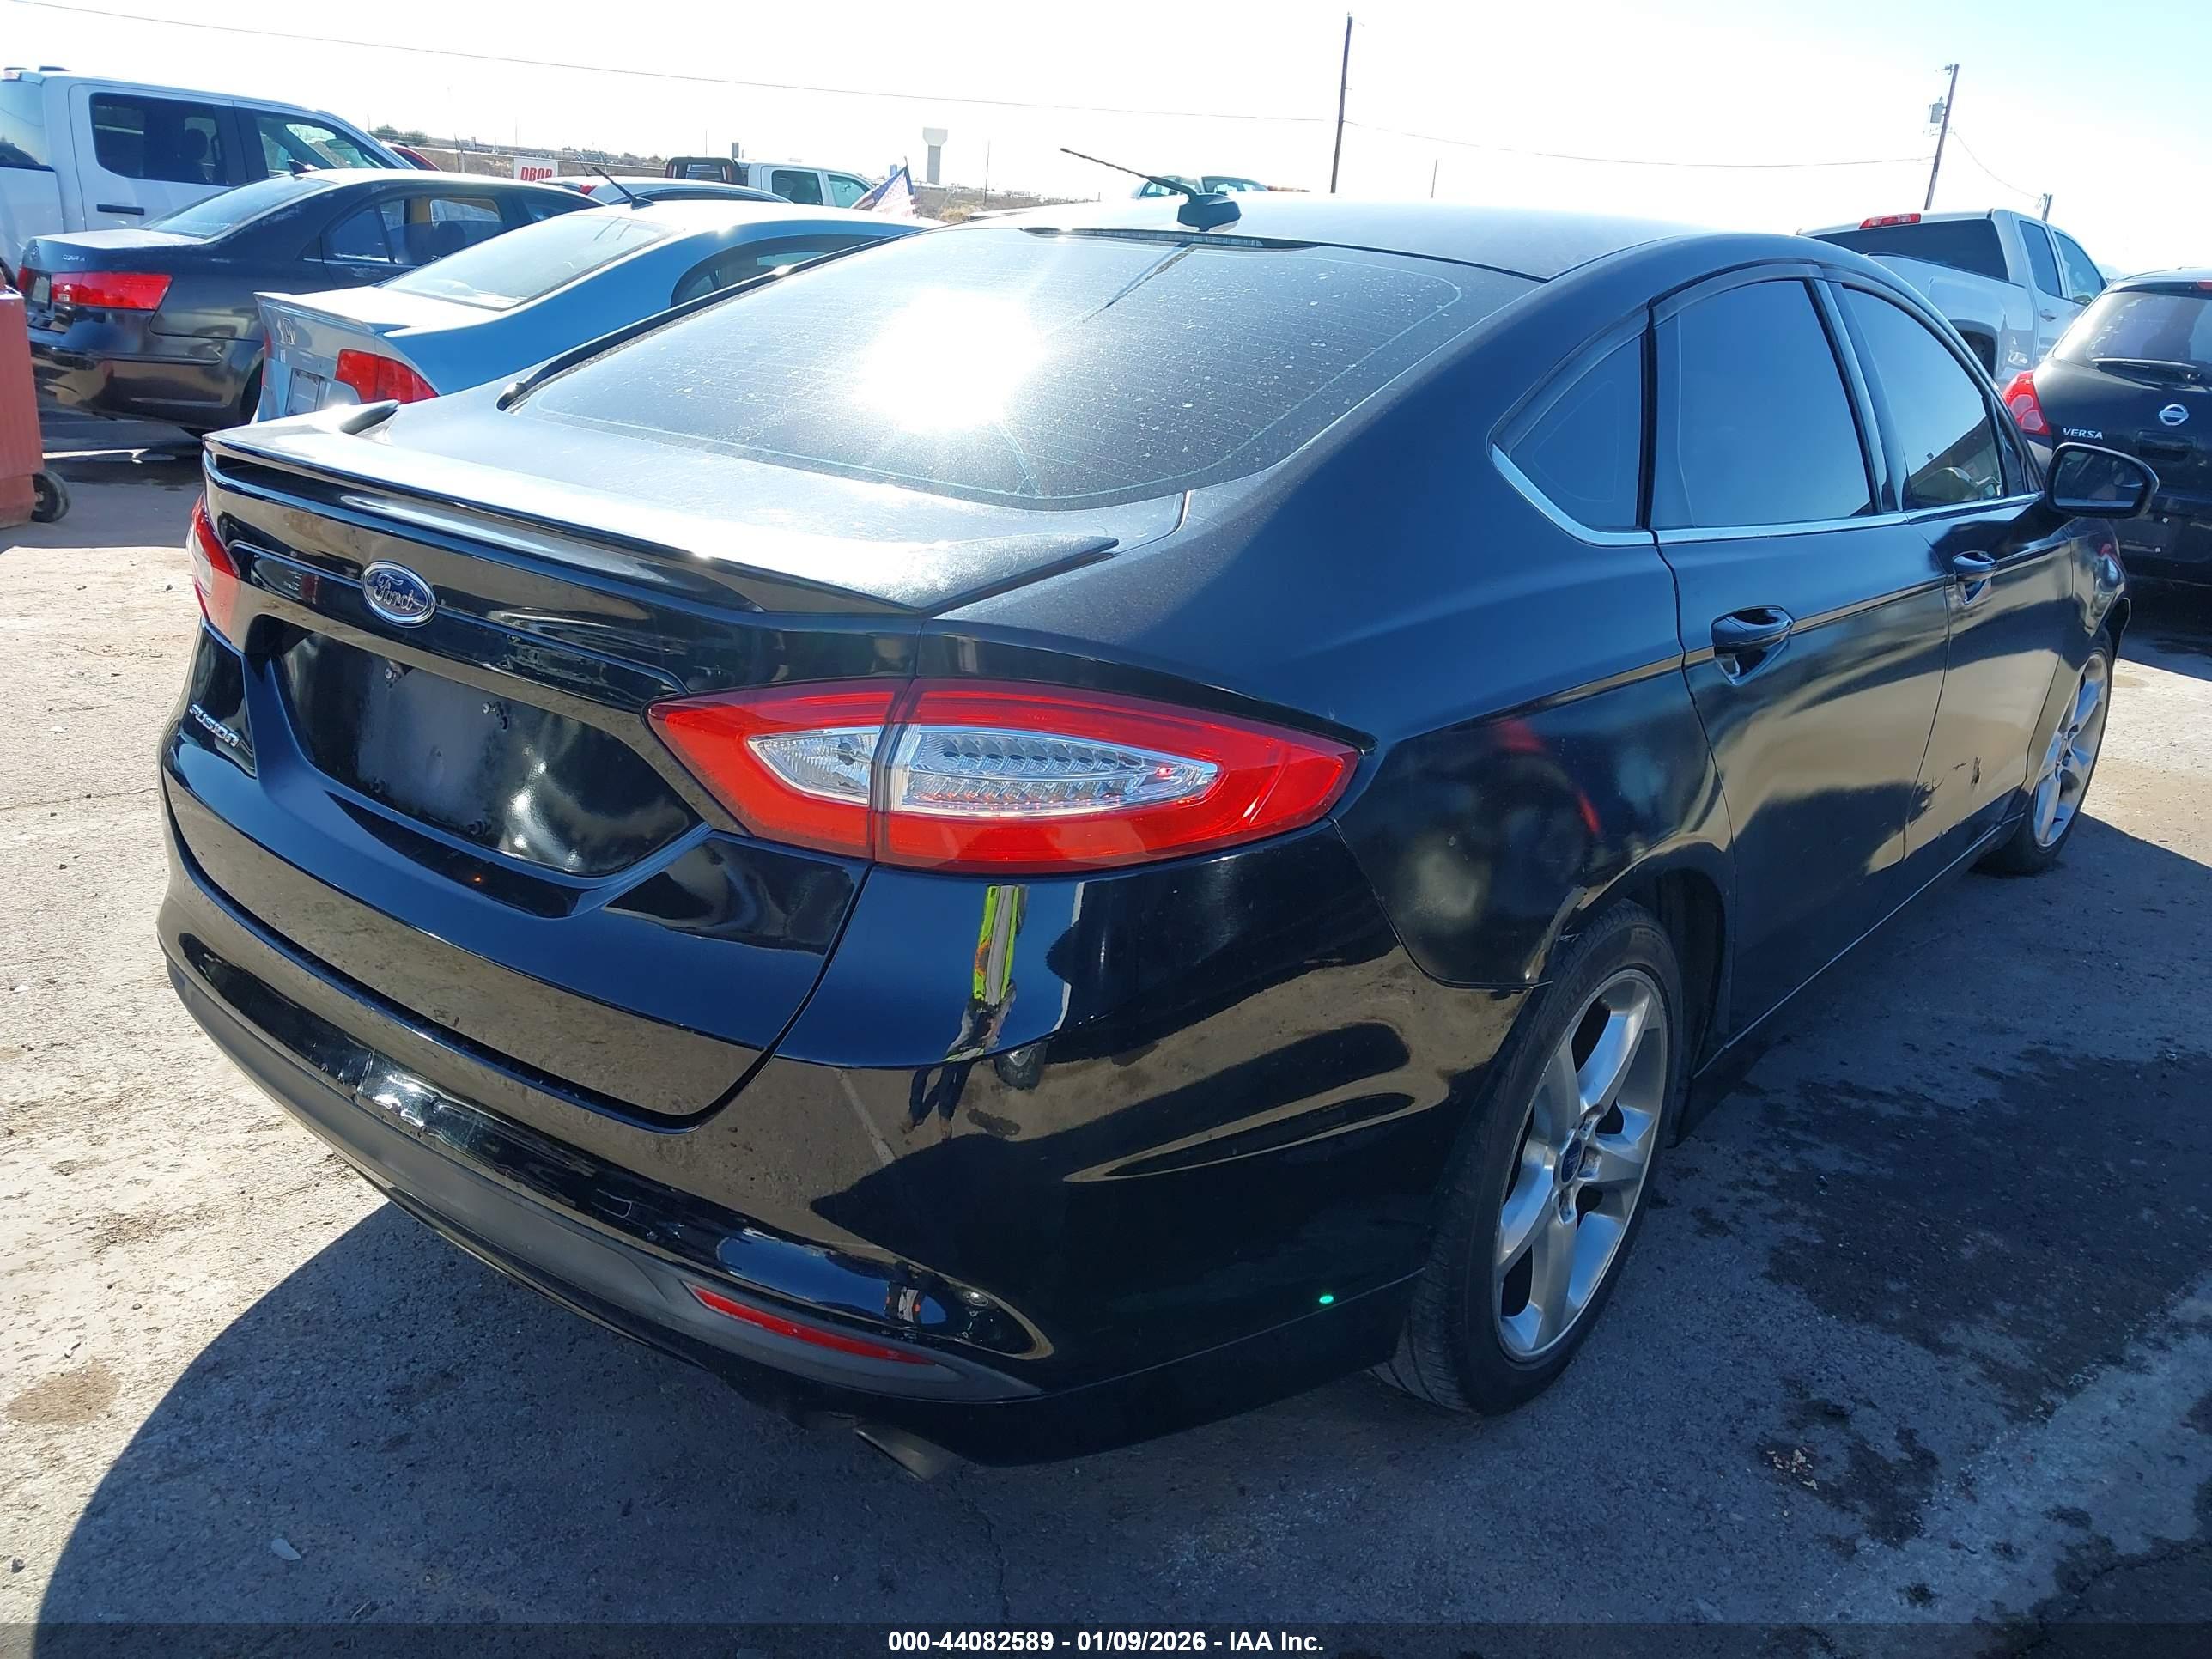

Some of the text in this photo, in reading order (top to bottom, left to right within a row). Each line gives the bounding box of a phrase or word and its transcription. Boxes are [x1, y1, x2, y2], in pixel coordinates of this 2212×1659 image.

[520, 166, 553, 182] DROP
[2063, 428, 2104, 441] VERSA
[374, 573, 428, 611] Ford
[189, 704, 240, 748] FUSION
